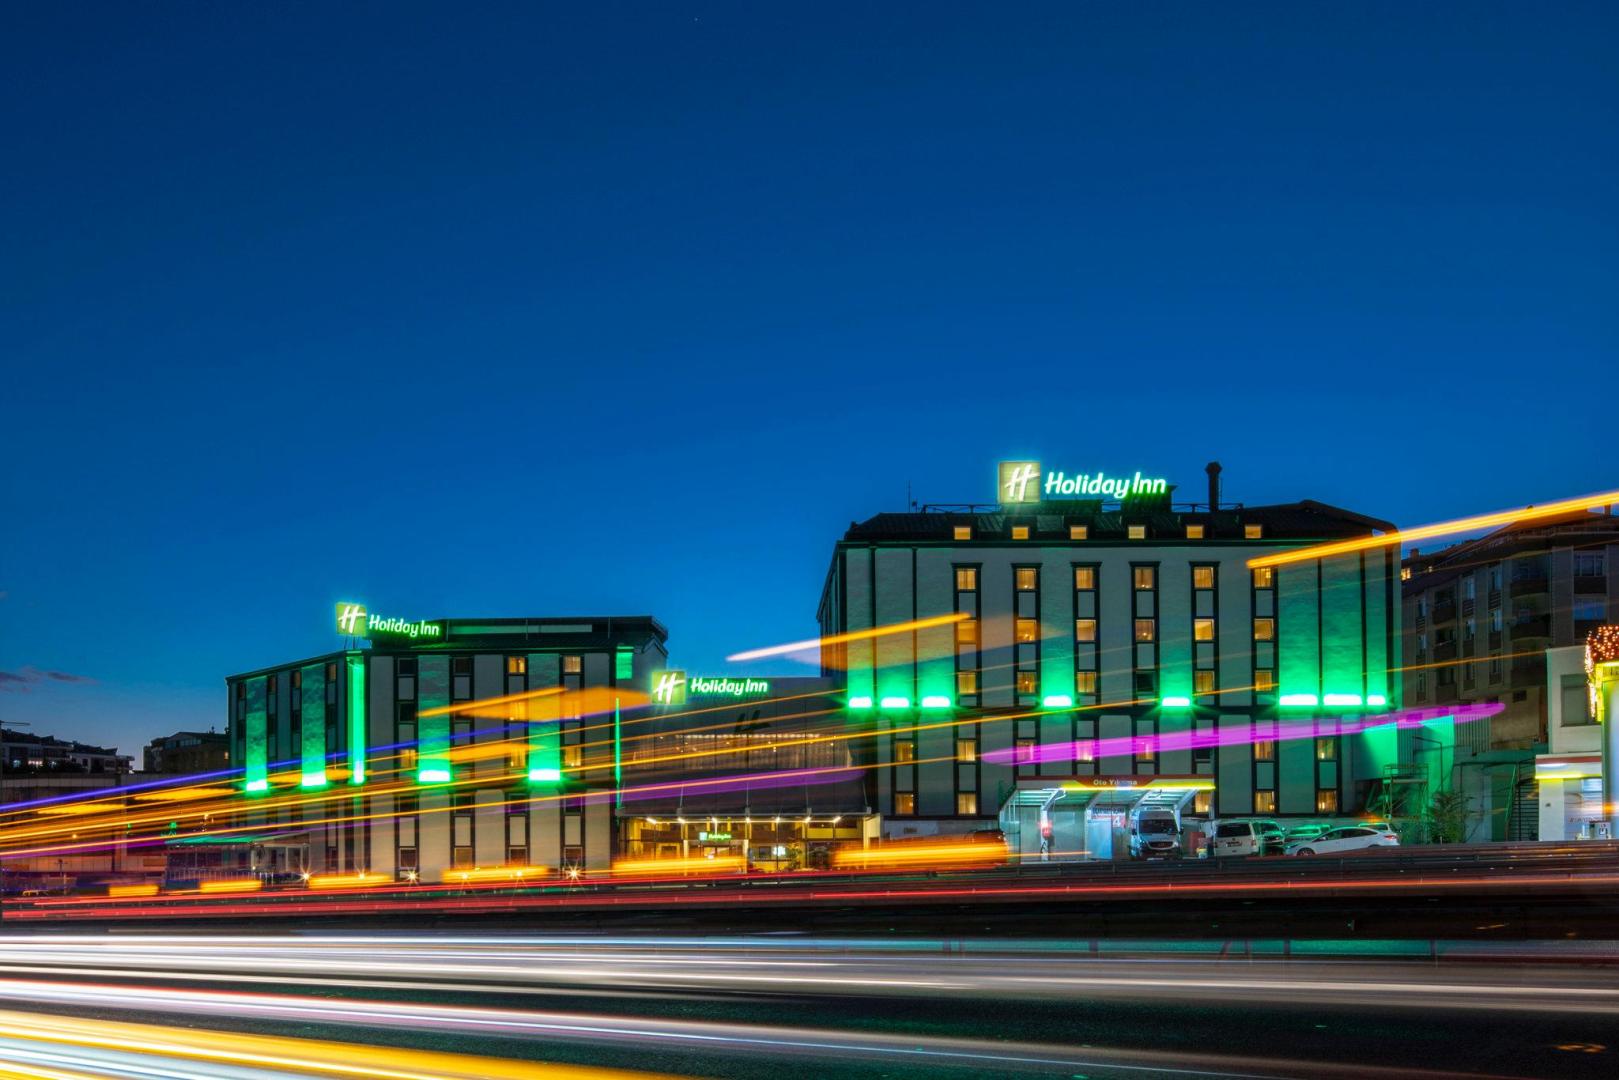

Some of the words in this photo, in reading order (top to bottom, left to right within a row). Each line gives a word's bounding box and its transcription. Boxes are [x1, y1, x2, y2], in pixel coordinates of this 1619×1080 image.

[1045, 471, 1130, 499] Holiday
[1132, 471, 1167, 494] Inn
[368, 613, 418, 638] Holiday
[420, 619, 440, 636] Inn
[690, 677, 744, 696] Holiday
[745, 678, 768, 693] Inn
